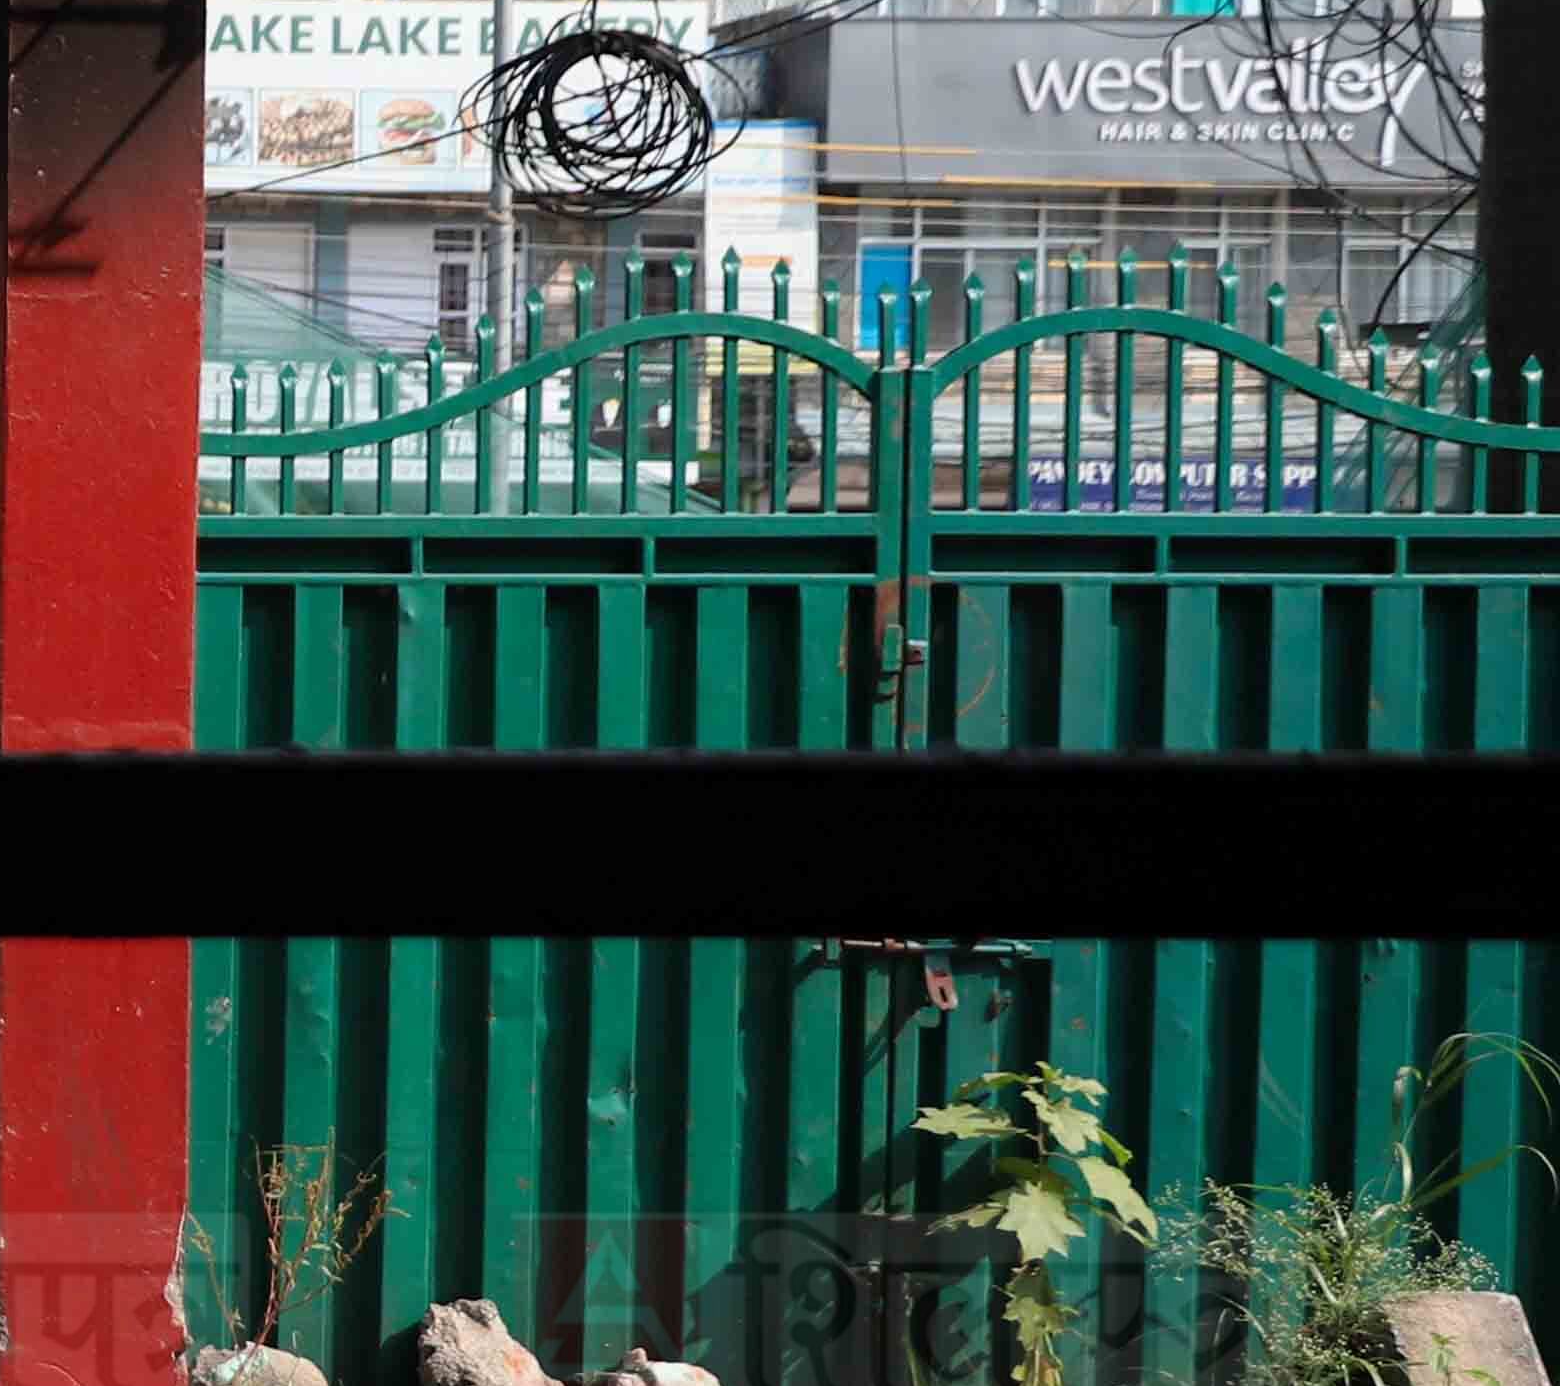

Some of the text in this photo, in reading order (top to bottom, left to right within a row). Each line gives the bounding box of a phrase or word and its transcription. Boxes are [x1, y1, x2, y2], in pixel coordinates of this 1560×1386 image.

[209, 14, 315, 54] AKE
[330, 15, 463, 56] LAKE
[1014, 36, 1427, 167] westvalley
[1097, 121, 1161, 142] HAIR
[1169, 121, 1187, 142] &
[1196, 121, 1259, 142] SKIN
